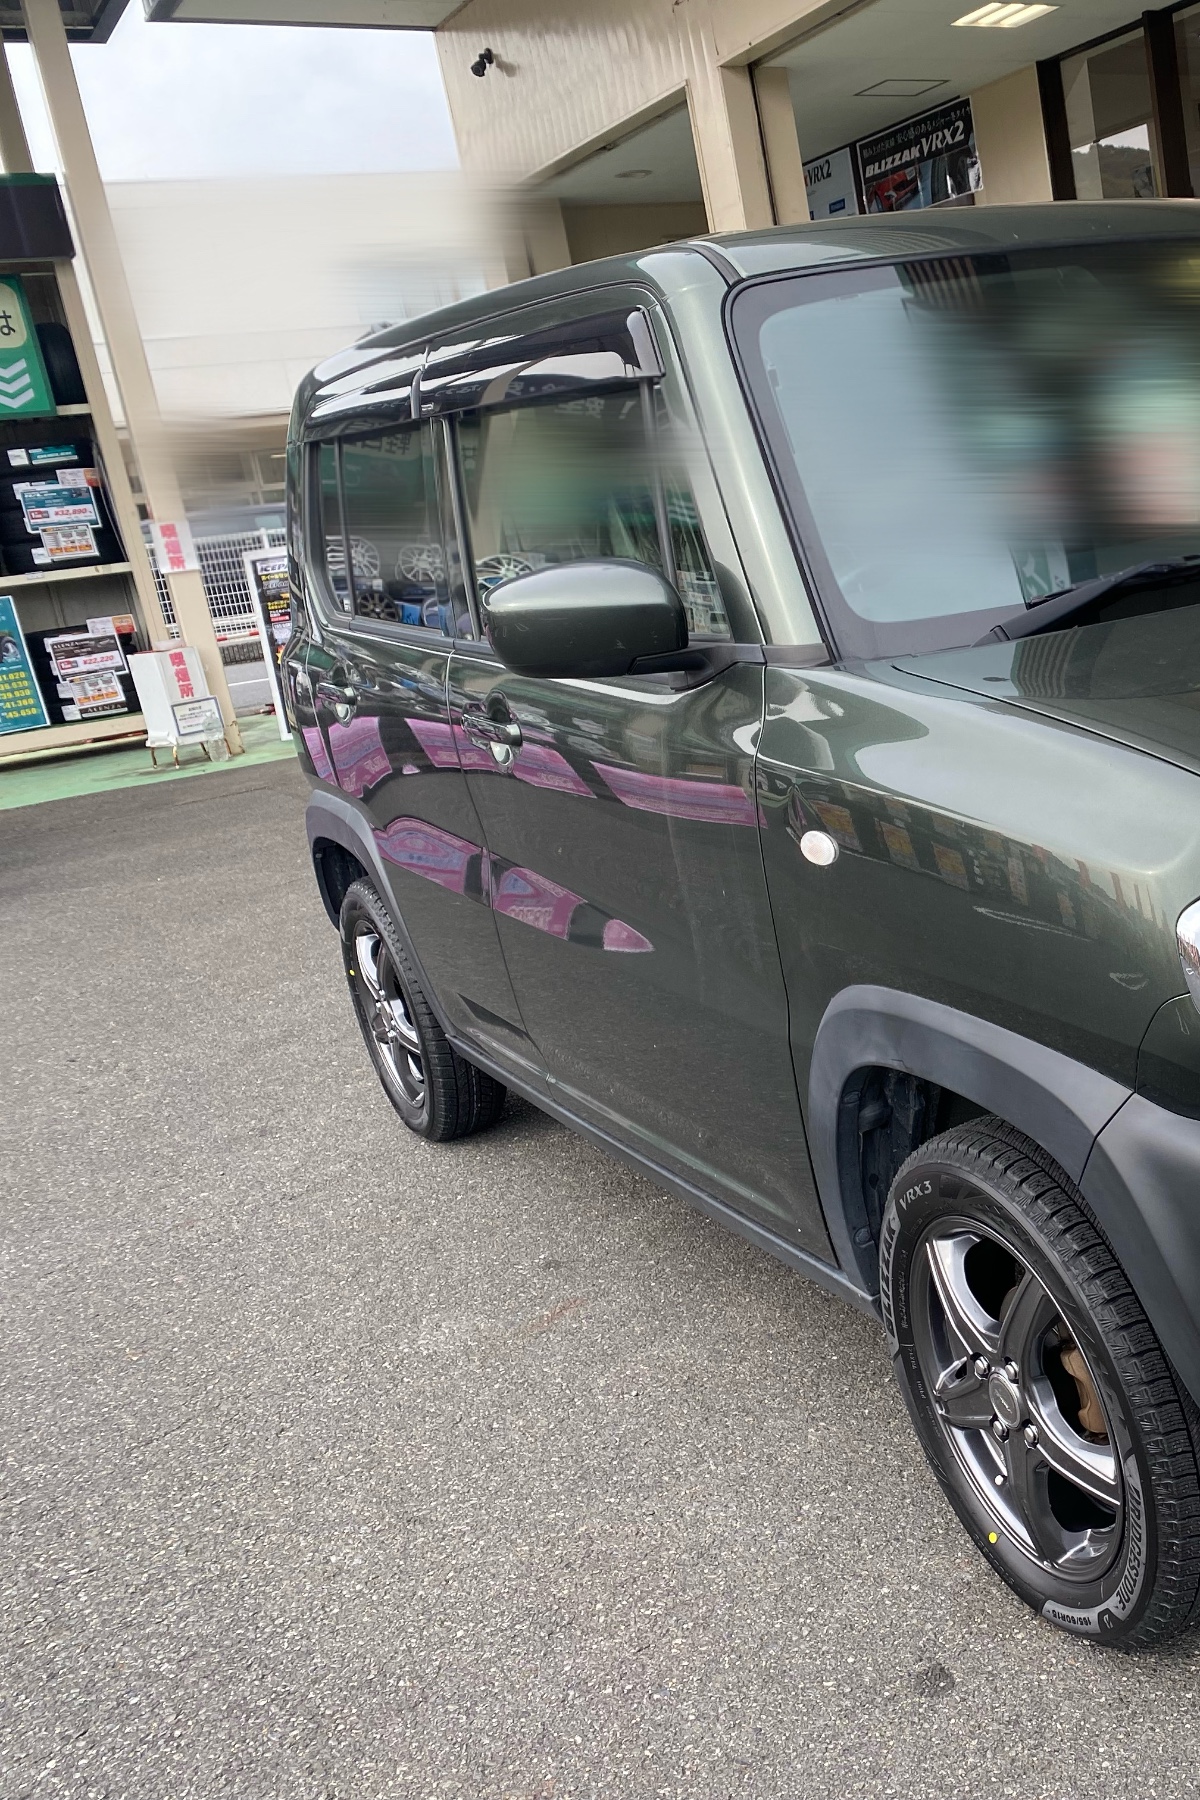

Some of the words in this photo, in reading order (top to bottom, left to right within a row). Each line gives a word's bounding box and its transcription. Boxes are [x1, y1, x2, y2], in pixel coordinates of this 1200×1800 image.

[866, 147, 920, 178] BLIZZAK
[921, 120, 964, 157] VRX2
[807, 159, 832, 186] VRX2
[169, 652, 194, 698] 喫煙所
[88, 704, 122, 713] ALENZA
[899, 1180, 932, 1211] VRX3
[1115, 1483, 1143, 1612] BRIDGESTONE
[1051, 1609, 1092, 1626] 165/60R15
